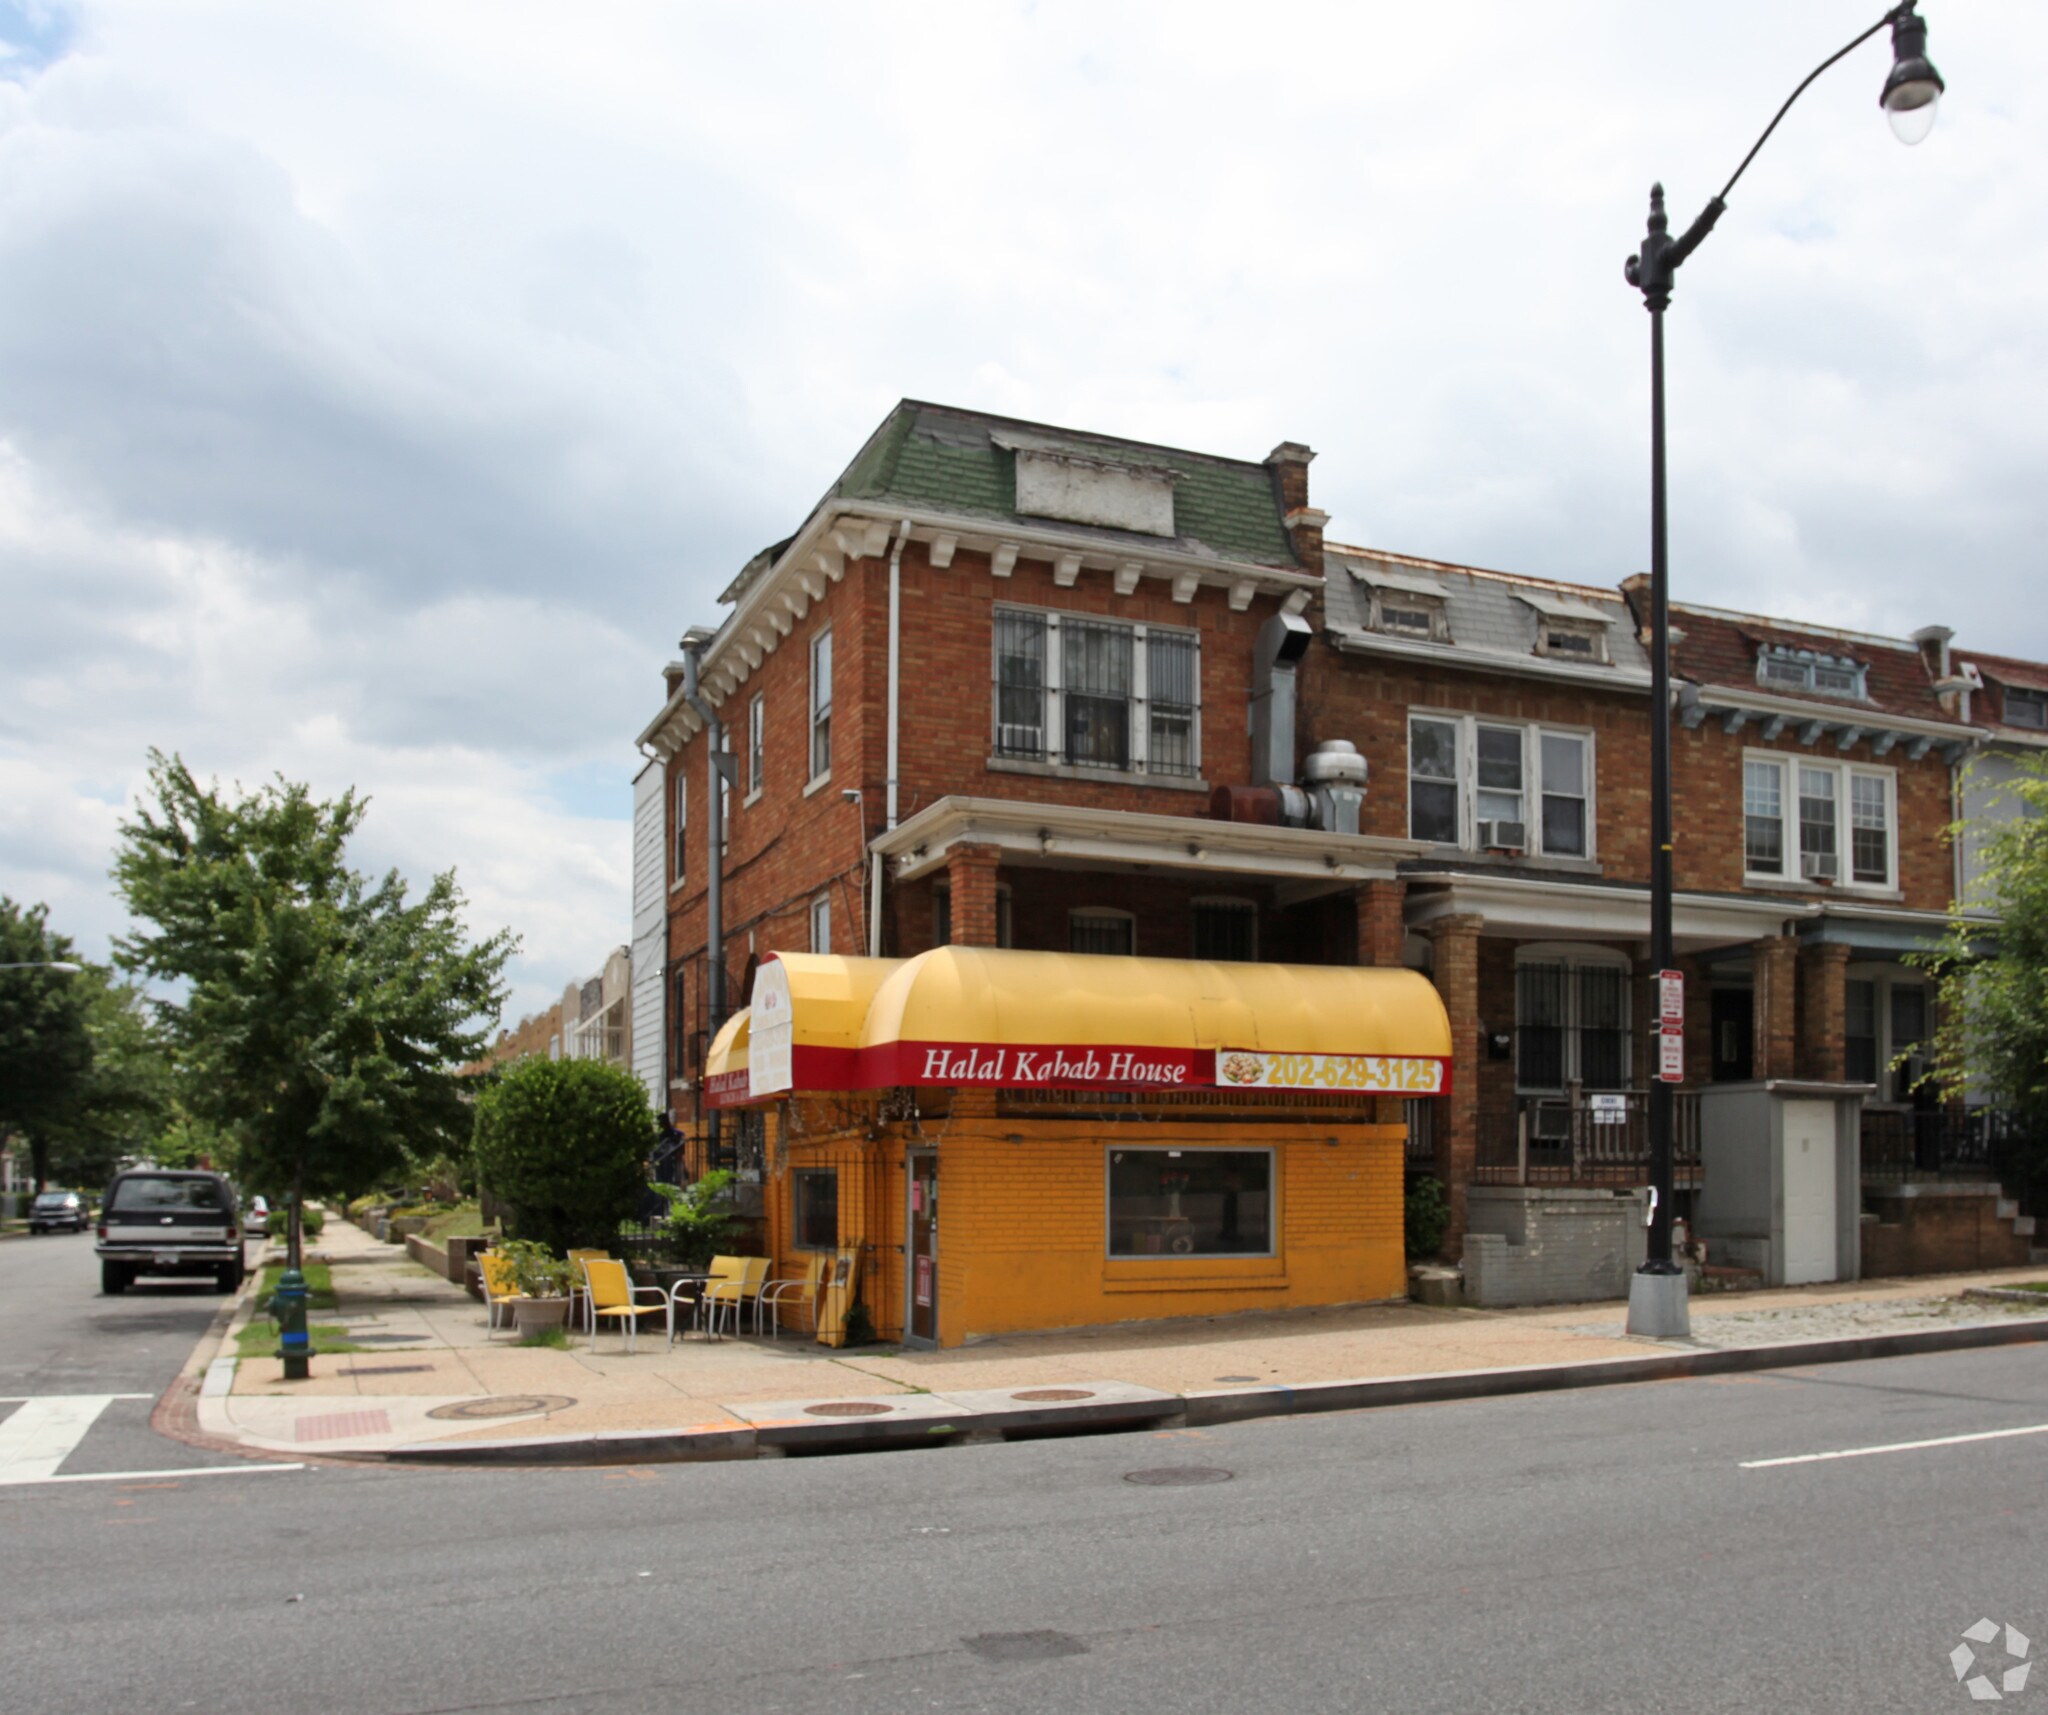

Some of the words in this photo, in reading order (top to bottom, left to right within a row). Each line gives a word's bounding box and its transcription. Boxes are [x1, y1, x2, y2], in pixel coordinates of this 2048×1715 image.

[921, 1048, 1005, 1080] Halal
[1012, 1049, 1100, 1081] Kabab
[1106, 1052, 1186, 1083] House
[1267, 1055, 1436, 1089] 202-629-3125
